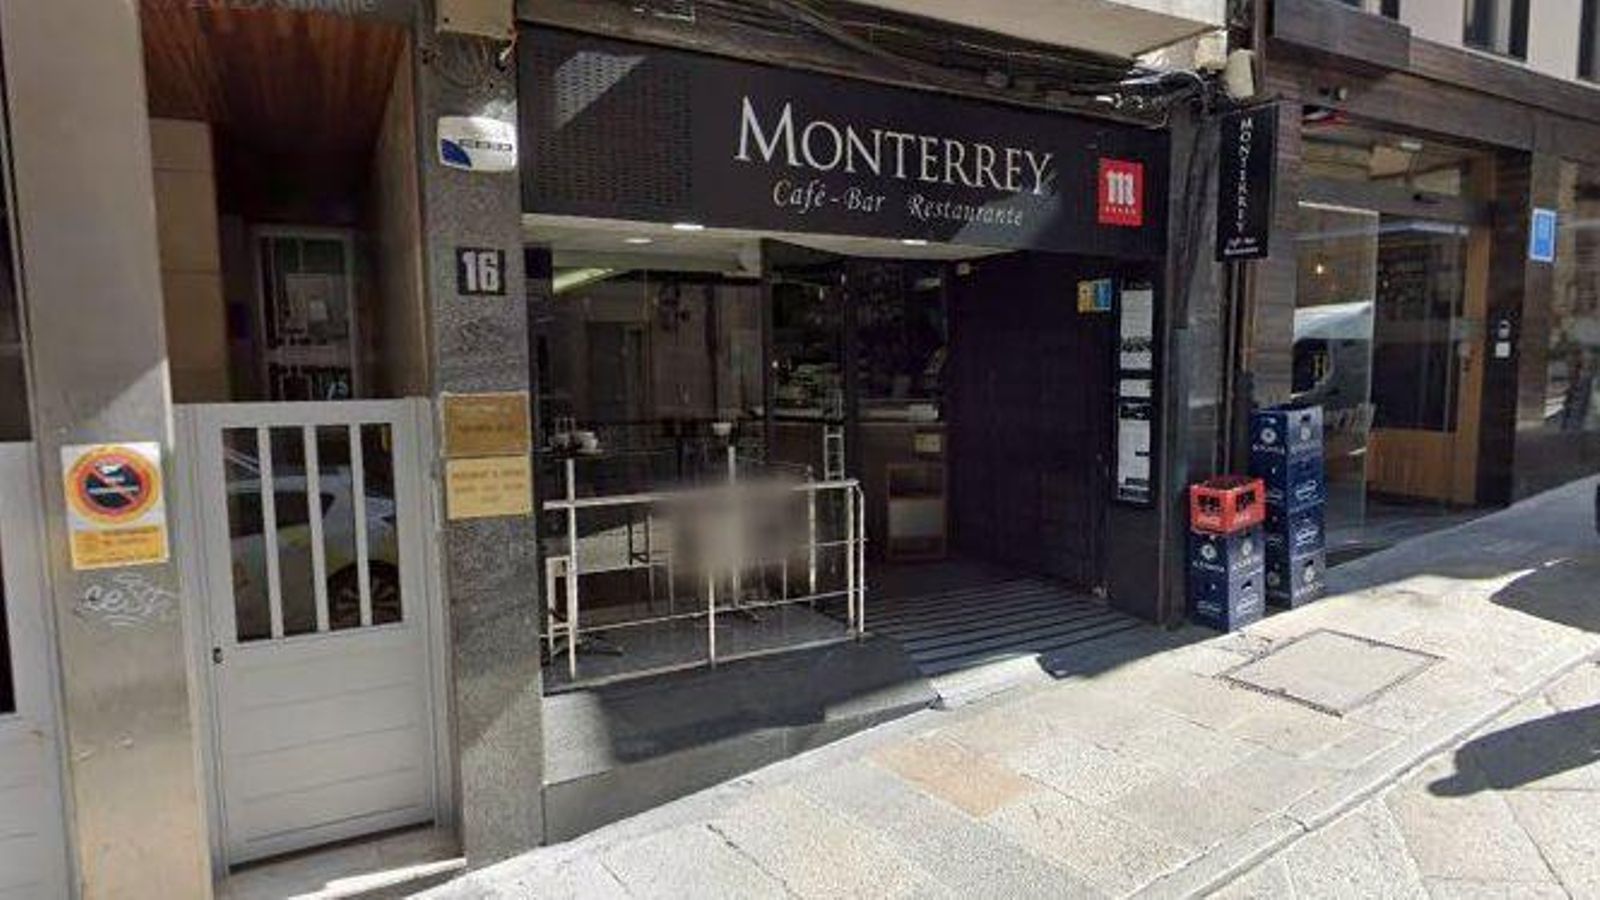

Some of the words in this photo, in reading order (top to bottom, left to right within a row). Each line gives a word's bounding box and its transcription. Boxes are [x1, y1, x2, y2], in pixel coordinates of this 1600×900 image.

[734, 95, 1054, 196] MONTERREY
[772, 178, 827, 215] Café
[846, 186, 886, 213] Bar
[907, 192, 1025, 228] Restaurante
[462, 251, 499, 291] 16
